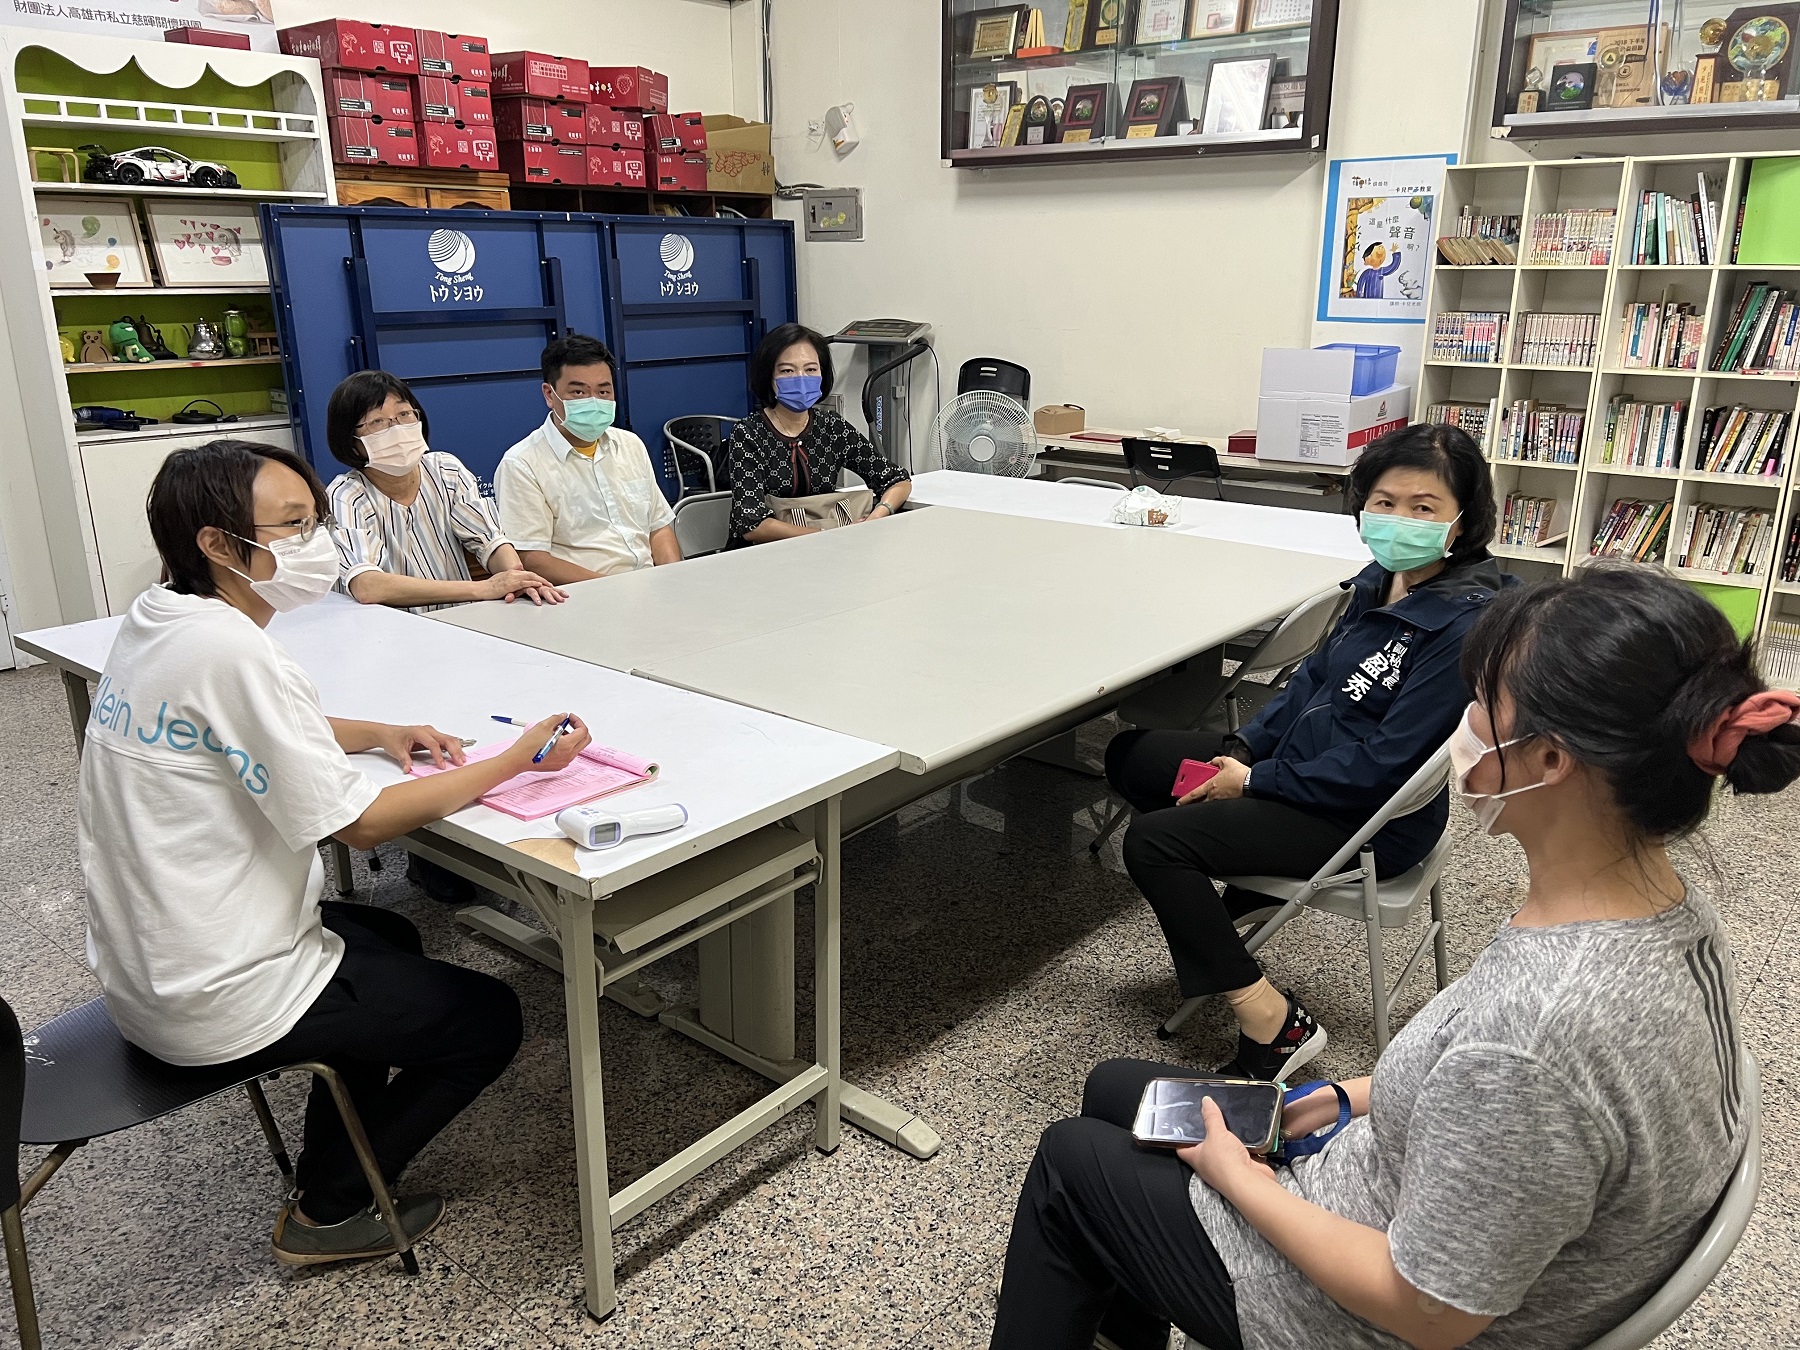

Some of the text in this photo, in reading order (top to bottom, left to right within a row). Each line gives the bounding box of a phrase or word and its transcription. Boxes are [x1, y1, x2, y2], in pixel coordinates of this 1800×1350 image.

[1389, 226, 1415, 239] 聲音
[434, 271, 453, 285] Tong
[1364, 421, 1397, 442] TILAPIA
[137, 701, 270, 795] Jeans
